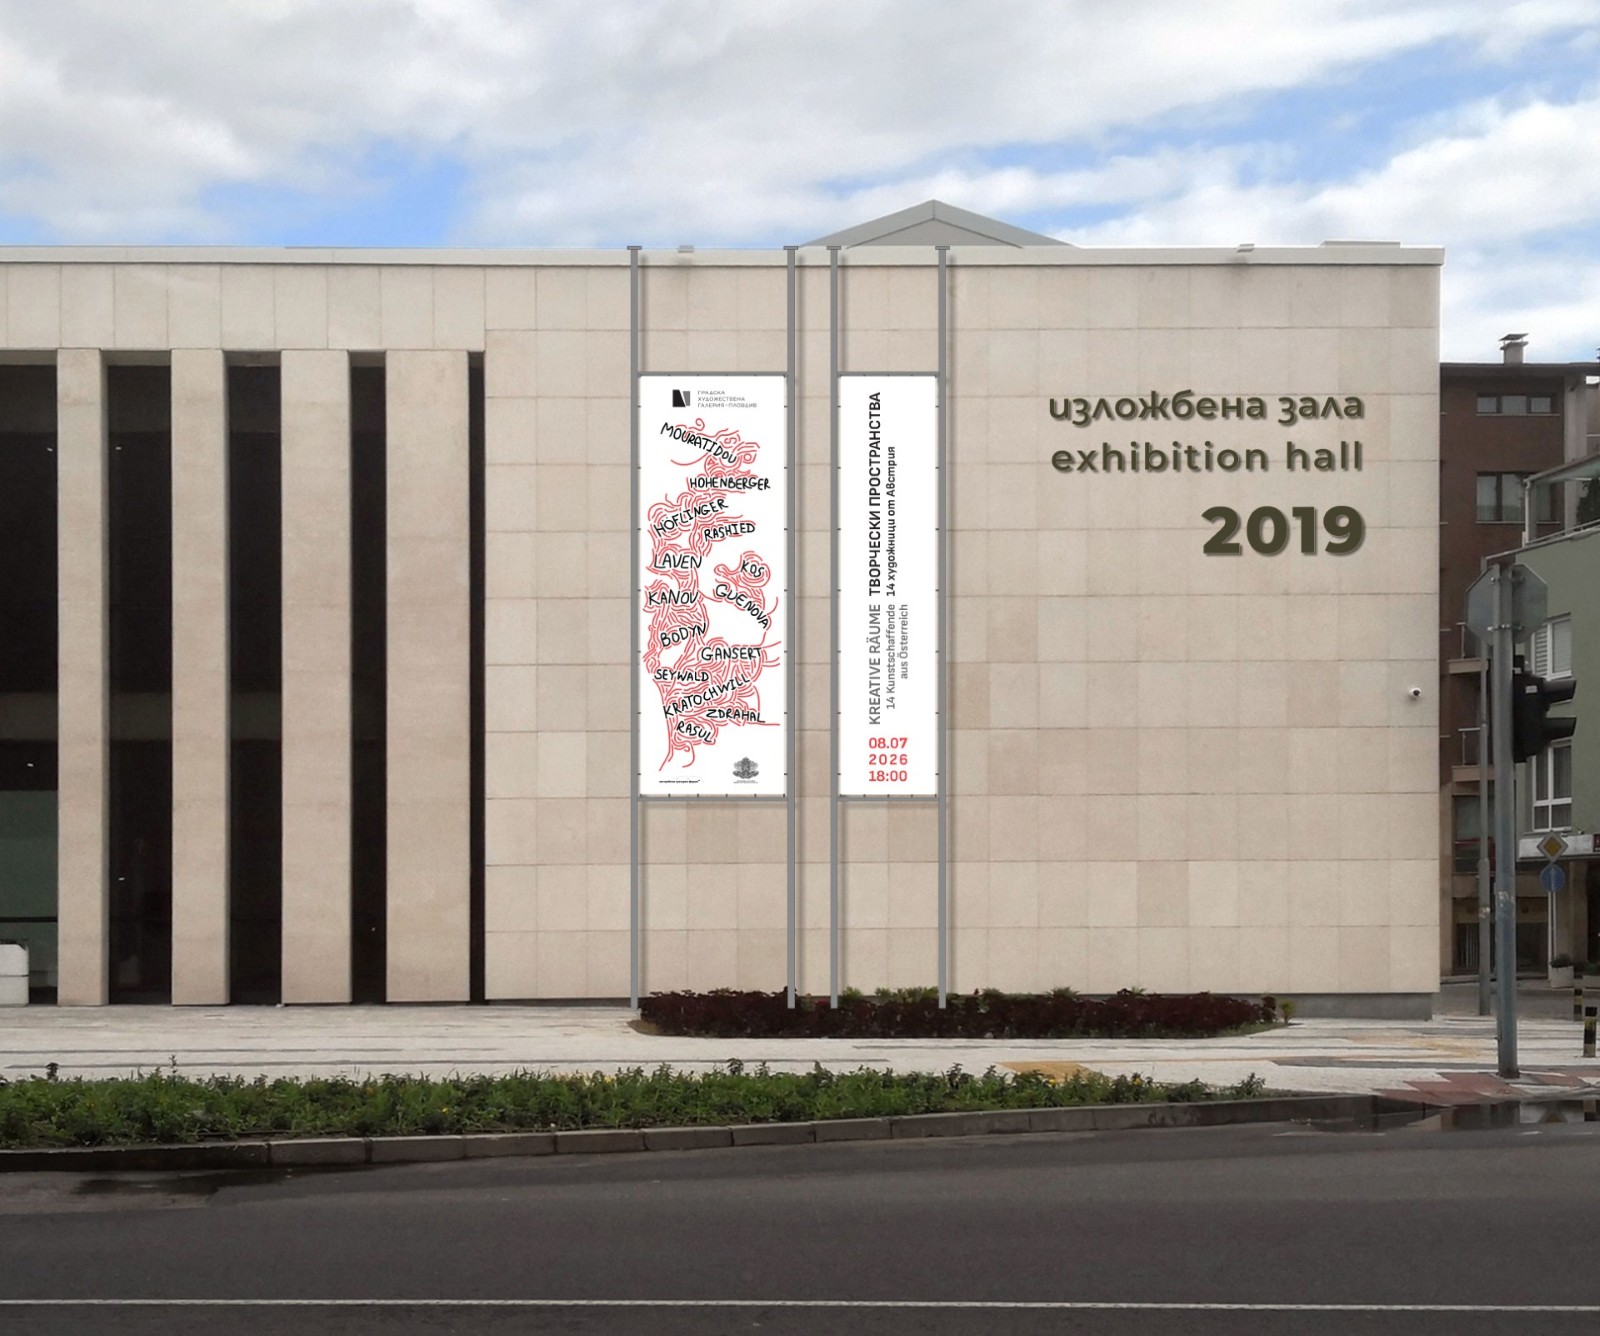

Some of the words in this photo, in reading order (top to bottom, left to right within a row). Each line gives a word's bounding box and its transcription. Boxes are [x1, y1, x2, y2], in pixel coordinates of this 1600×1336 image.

[1049, 389, 1266, 427] изложбена
[1278, 396, 1365, 426] зала
[661, 423, 737, 463] MOURATIDOU
[868, 391, 881, 507] ПРОСТРАНСТВА
[1051, 441, 1269, 472] exhibition
[1286, 441, 1363, 471] hall
[689, 476, 771, 490] HOHENBERGER
[886, 446, 898, 498] Австрия
[653, 498, 729, 538] HÖFLINGER
[888, 499, 896, 517] от
[703, 522, 756, 542] RASHIED
[1201, 505, 1367, 556] 2019
[653, 553, 702, 569] LAVEN
[868, 510, 881, 597] ТВОРЧЕСКИ
[886, 518, 898, 581] художници
[740, 560, 765, 578] KOS
[886, 582, 896, 597] 14
[715, 583, 769, 629] GUENOVA
[660, 622, 706, 647] BODYN
[866, 604, 881, 654] RÄUME
[898, 604, 909, 659] Österreich
[701, 646, 761, 661] GANSERT
[886, 604, 897, 694] Kunstschaffende
[654, 668, 709, 682] SEYWALD
[900, 661, 909, 680] aus
[663, 674, 751, 719] KRATOCHWILL
[868, 657, 881, 725] KREATIVE
[886, 696, 896, 710] 14
[705, 708, 766, 723] ZDRAHAL
[676, 720, 714, 743] RASUL
[868, 737, 908, 749] 08.07
[868, 753, 908, 765] 2026
[868, 769, 908, 782] 18:00
